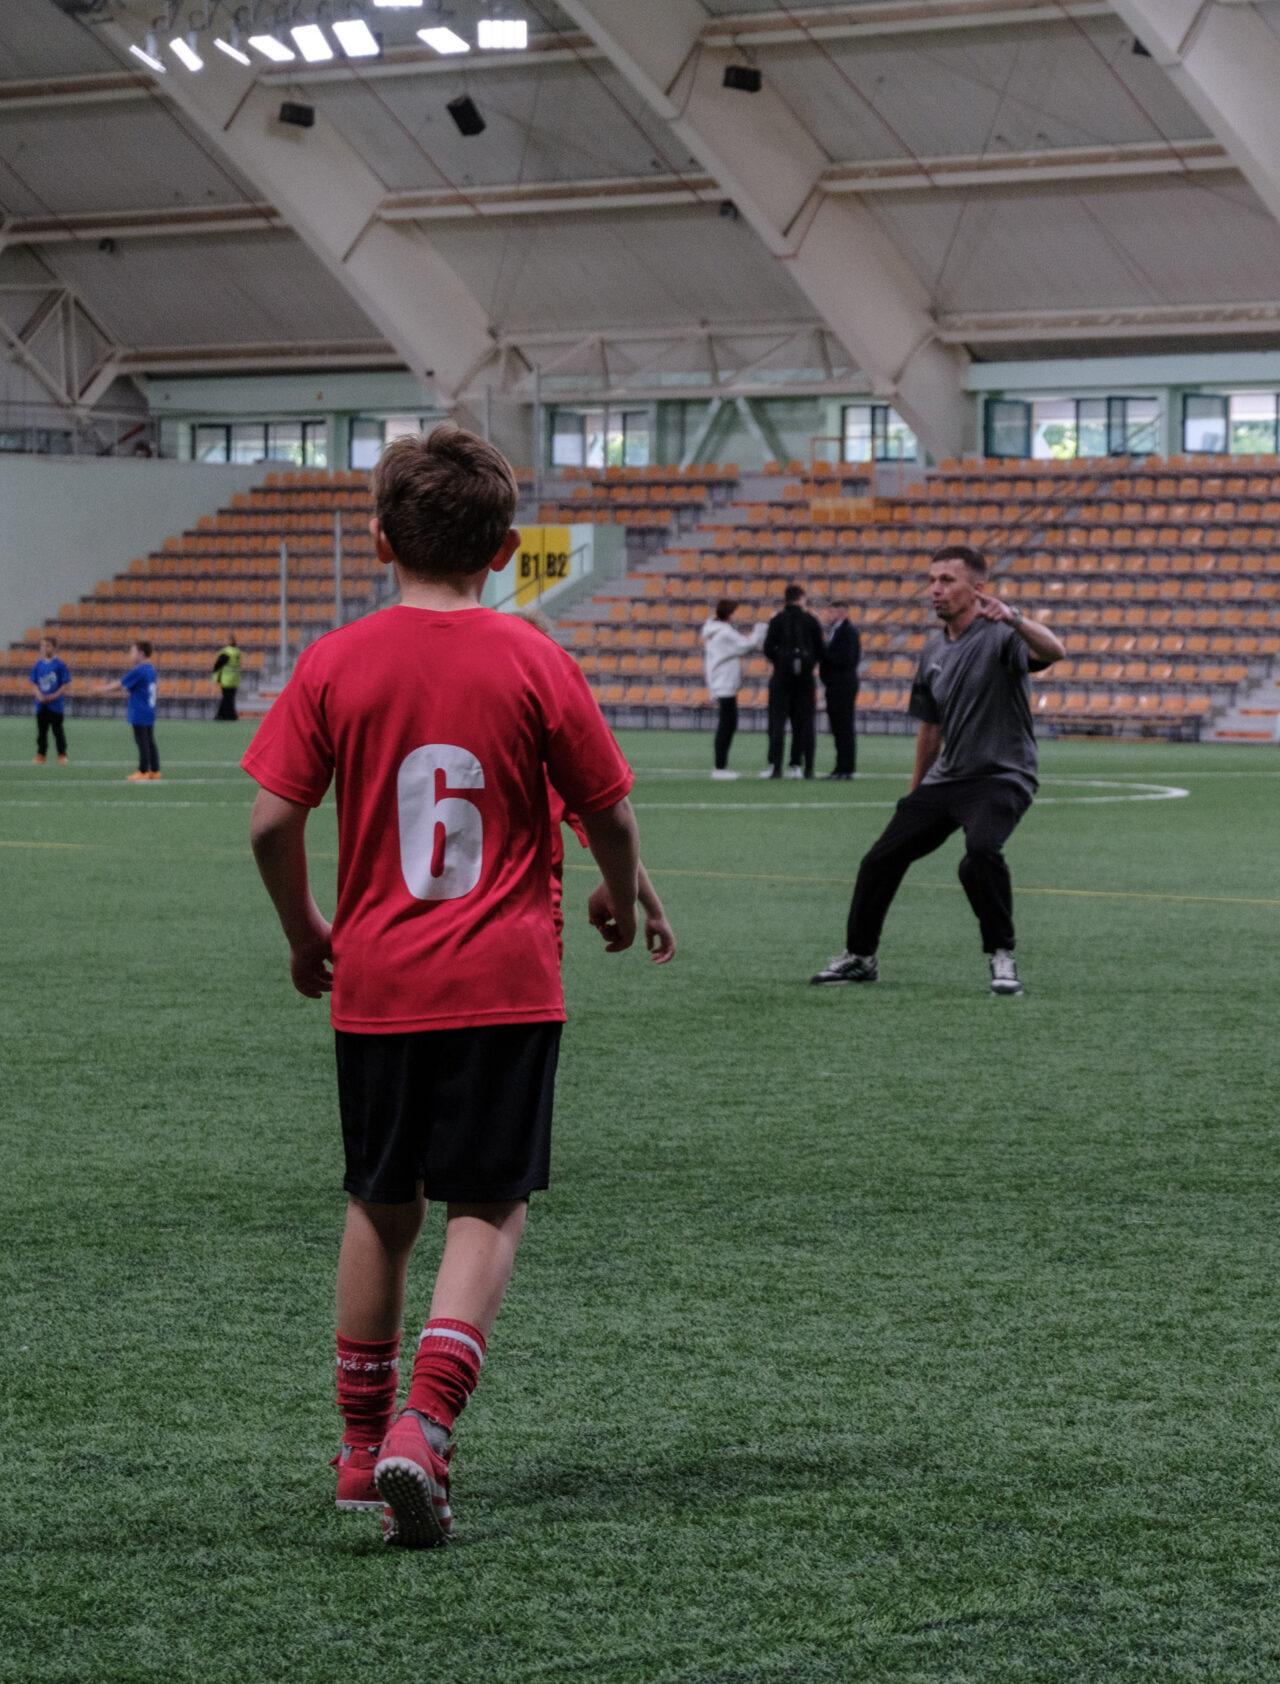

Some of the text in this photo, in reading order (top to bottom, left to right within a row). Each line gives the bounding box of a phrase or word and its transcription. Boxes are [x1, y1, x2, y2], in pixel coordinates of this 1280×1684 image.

[521, 552, 568, 578] B1 B2
[397, 743, 485, 900] 6
